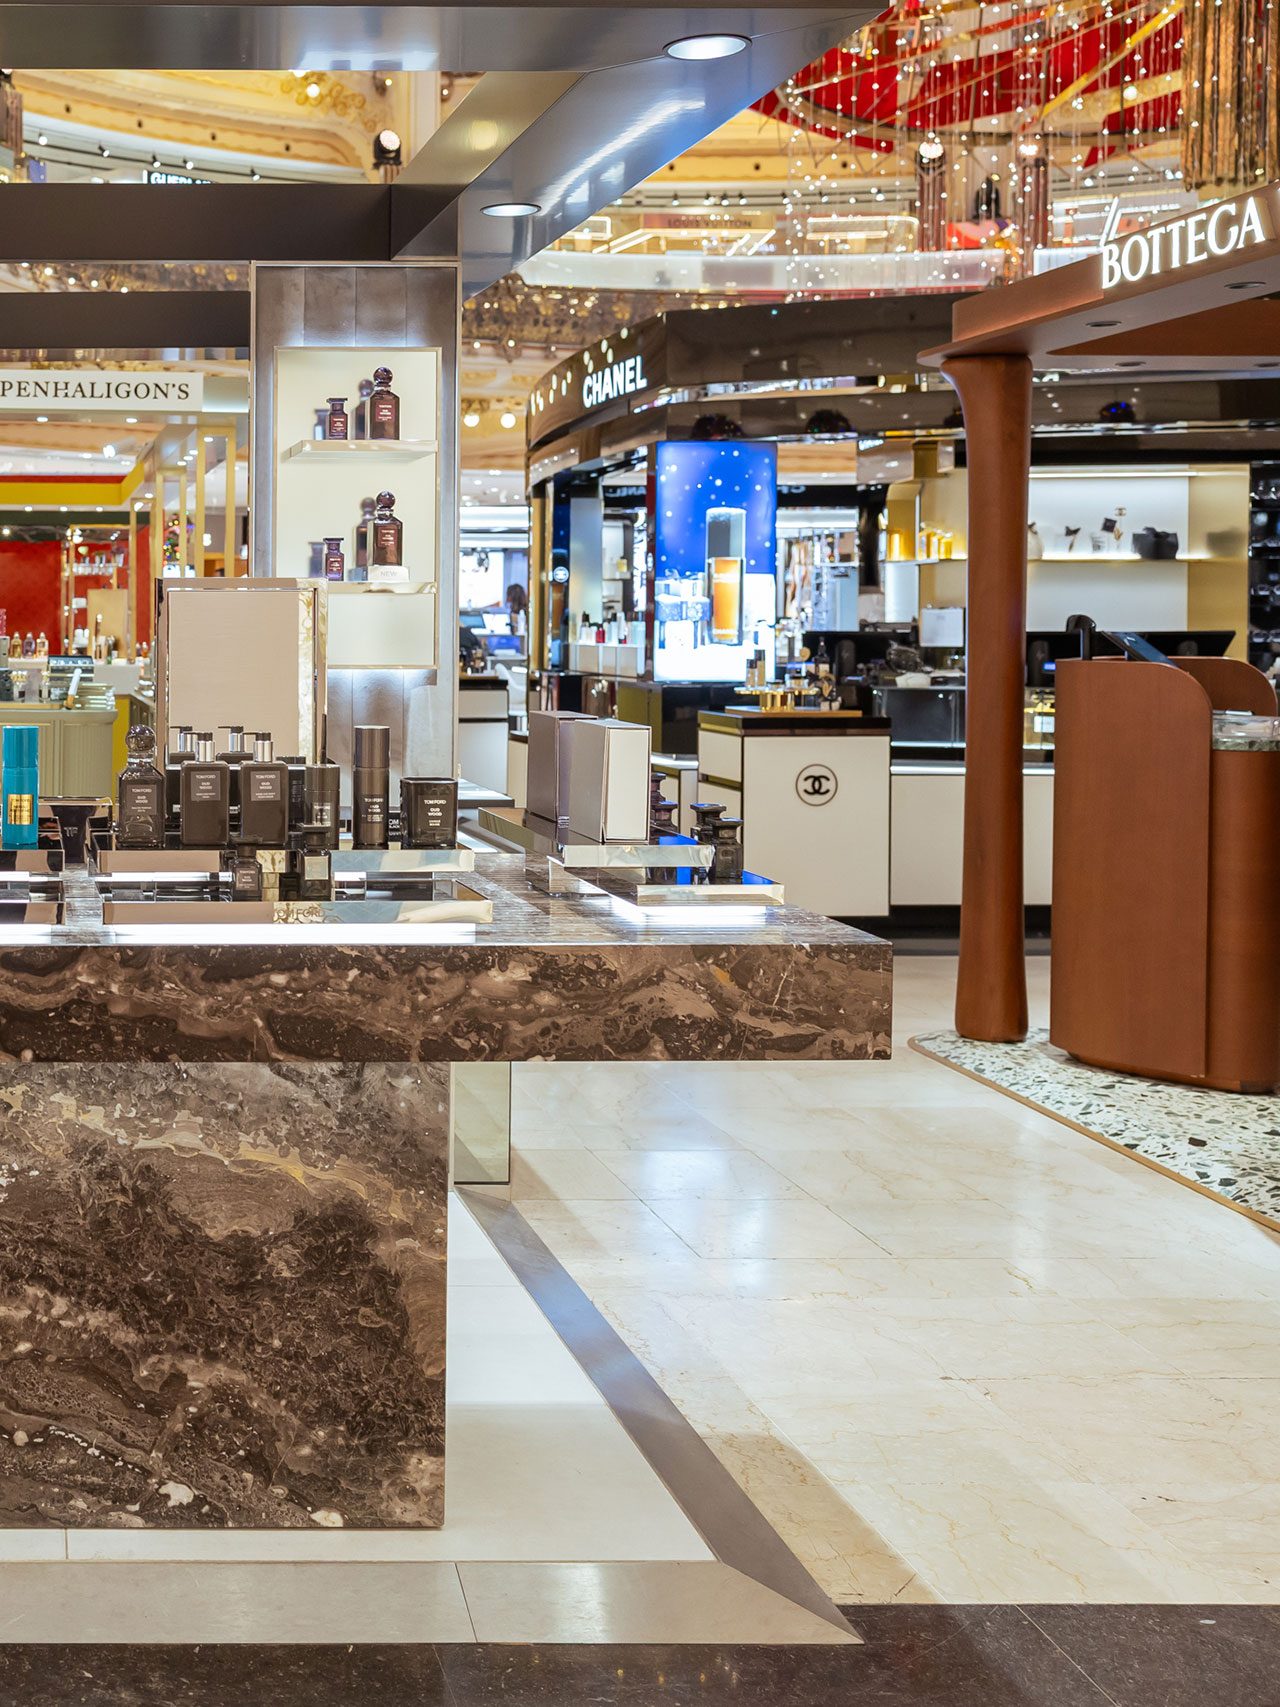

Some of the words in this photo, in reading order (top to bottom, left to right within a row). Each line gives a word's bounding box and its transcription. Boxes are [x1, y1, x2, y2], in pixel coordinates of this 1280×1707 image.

[1101, 196, 1266, 289] BOTTEGA
[0, 380, 190, 401] PENHALIGON'S
[582, 355, 648, 408] CHANEL
[64, 826, 79, 837] TF
